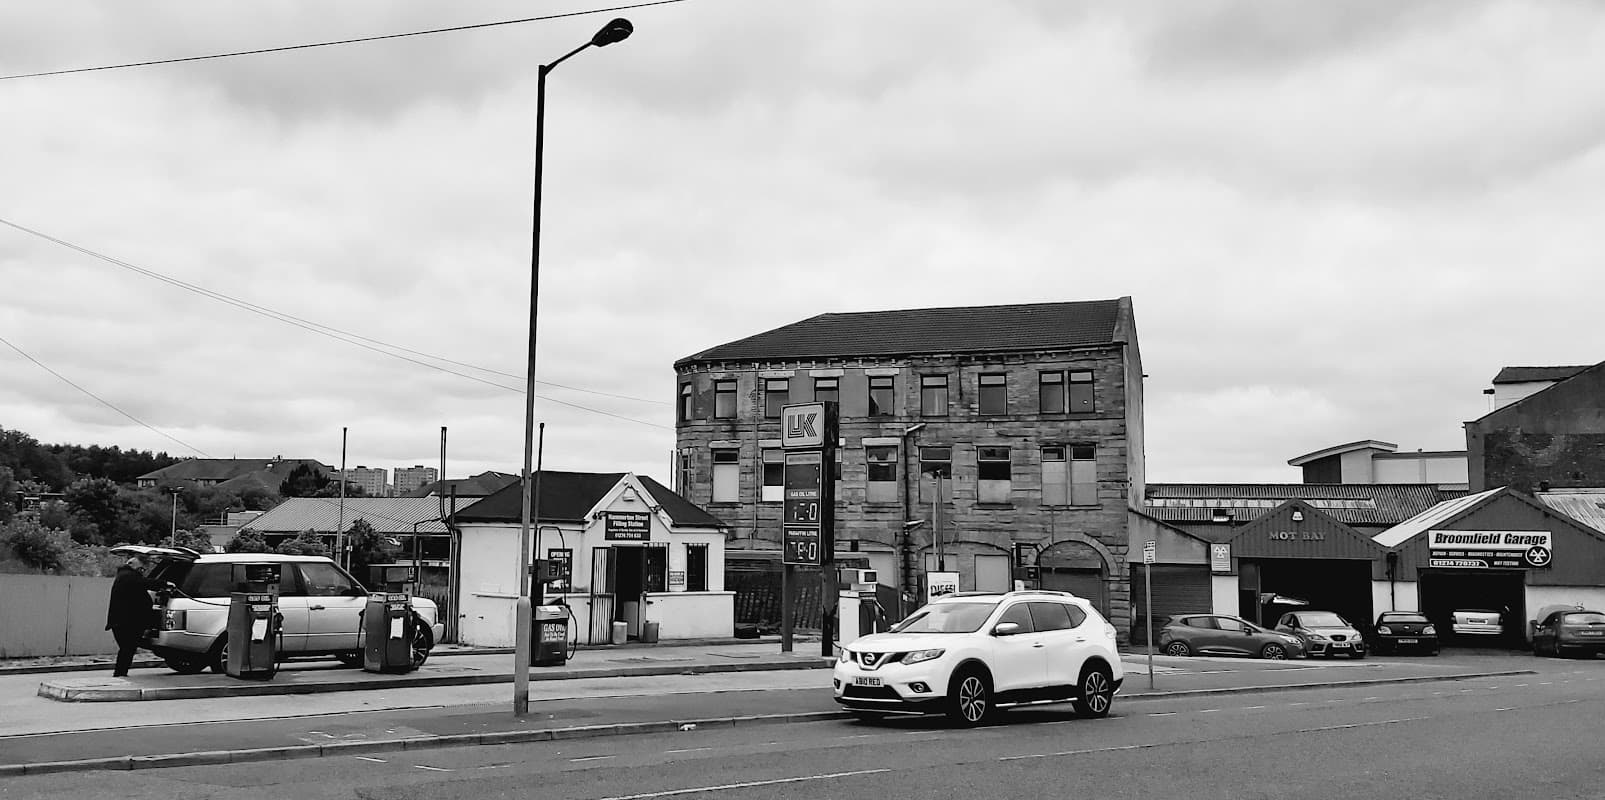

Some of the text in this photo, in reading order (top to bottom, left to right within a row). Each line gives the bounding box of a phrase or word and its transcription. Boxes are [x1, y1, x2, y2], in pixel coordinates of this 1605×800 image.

[787, 412, 817, 439] UK
[1269, 531, 1328, 540] MOT BAY
[1433, 532, 1548, 546] Broomfield Garage
